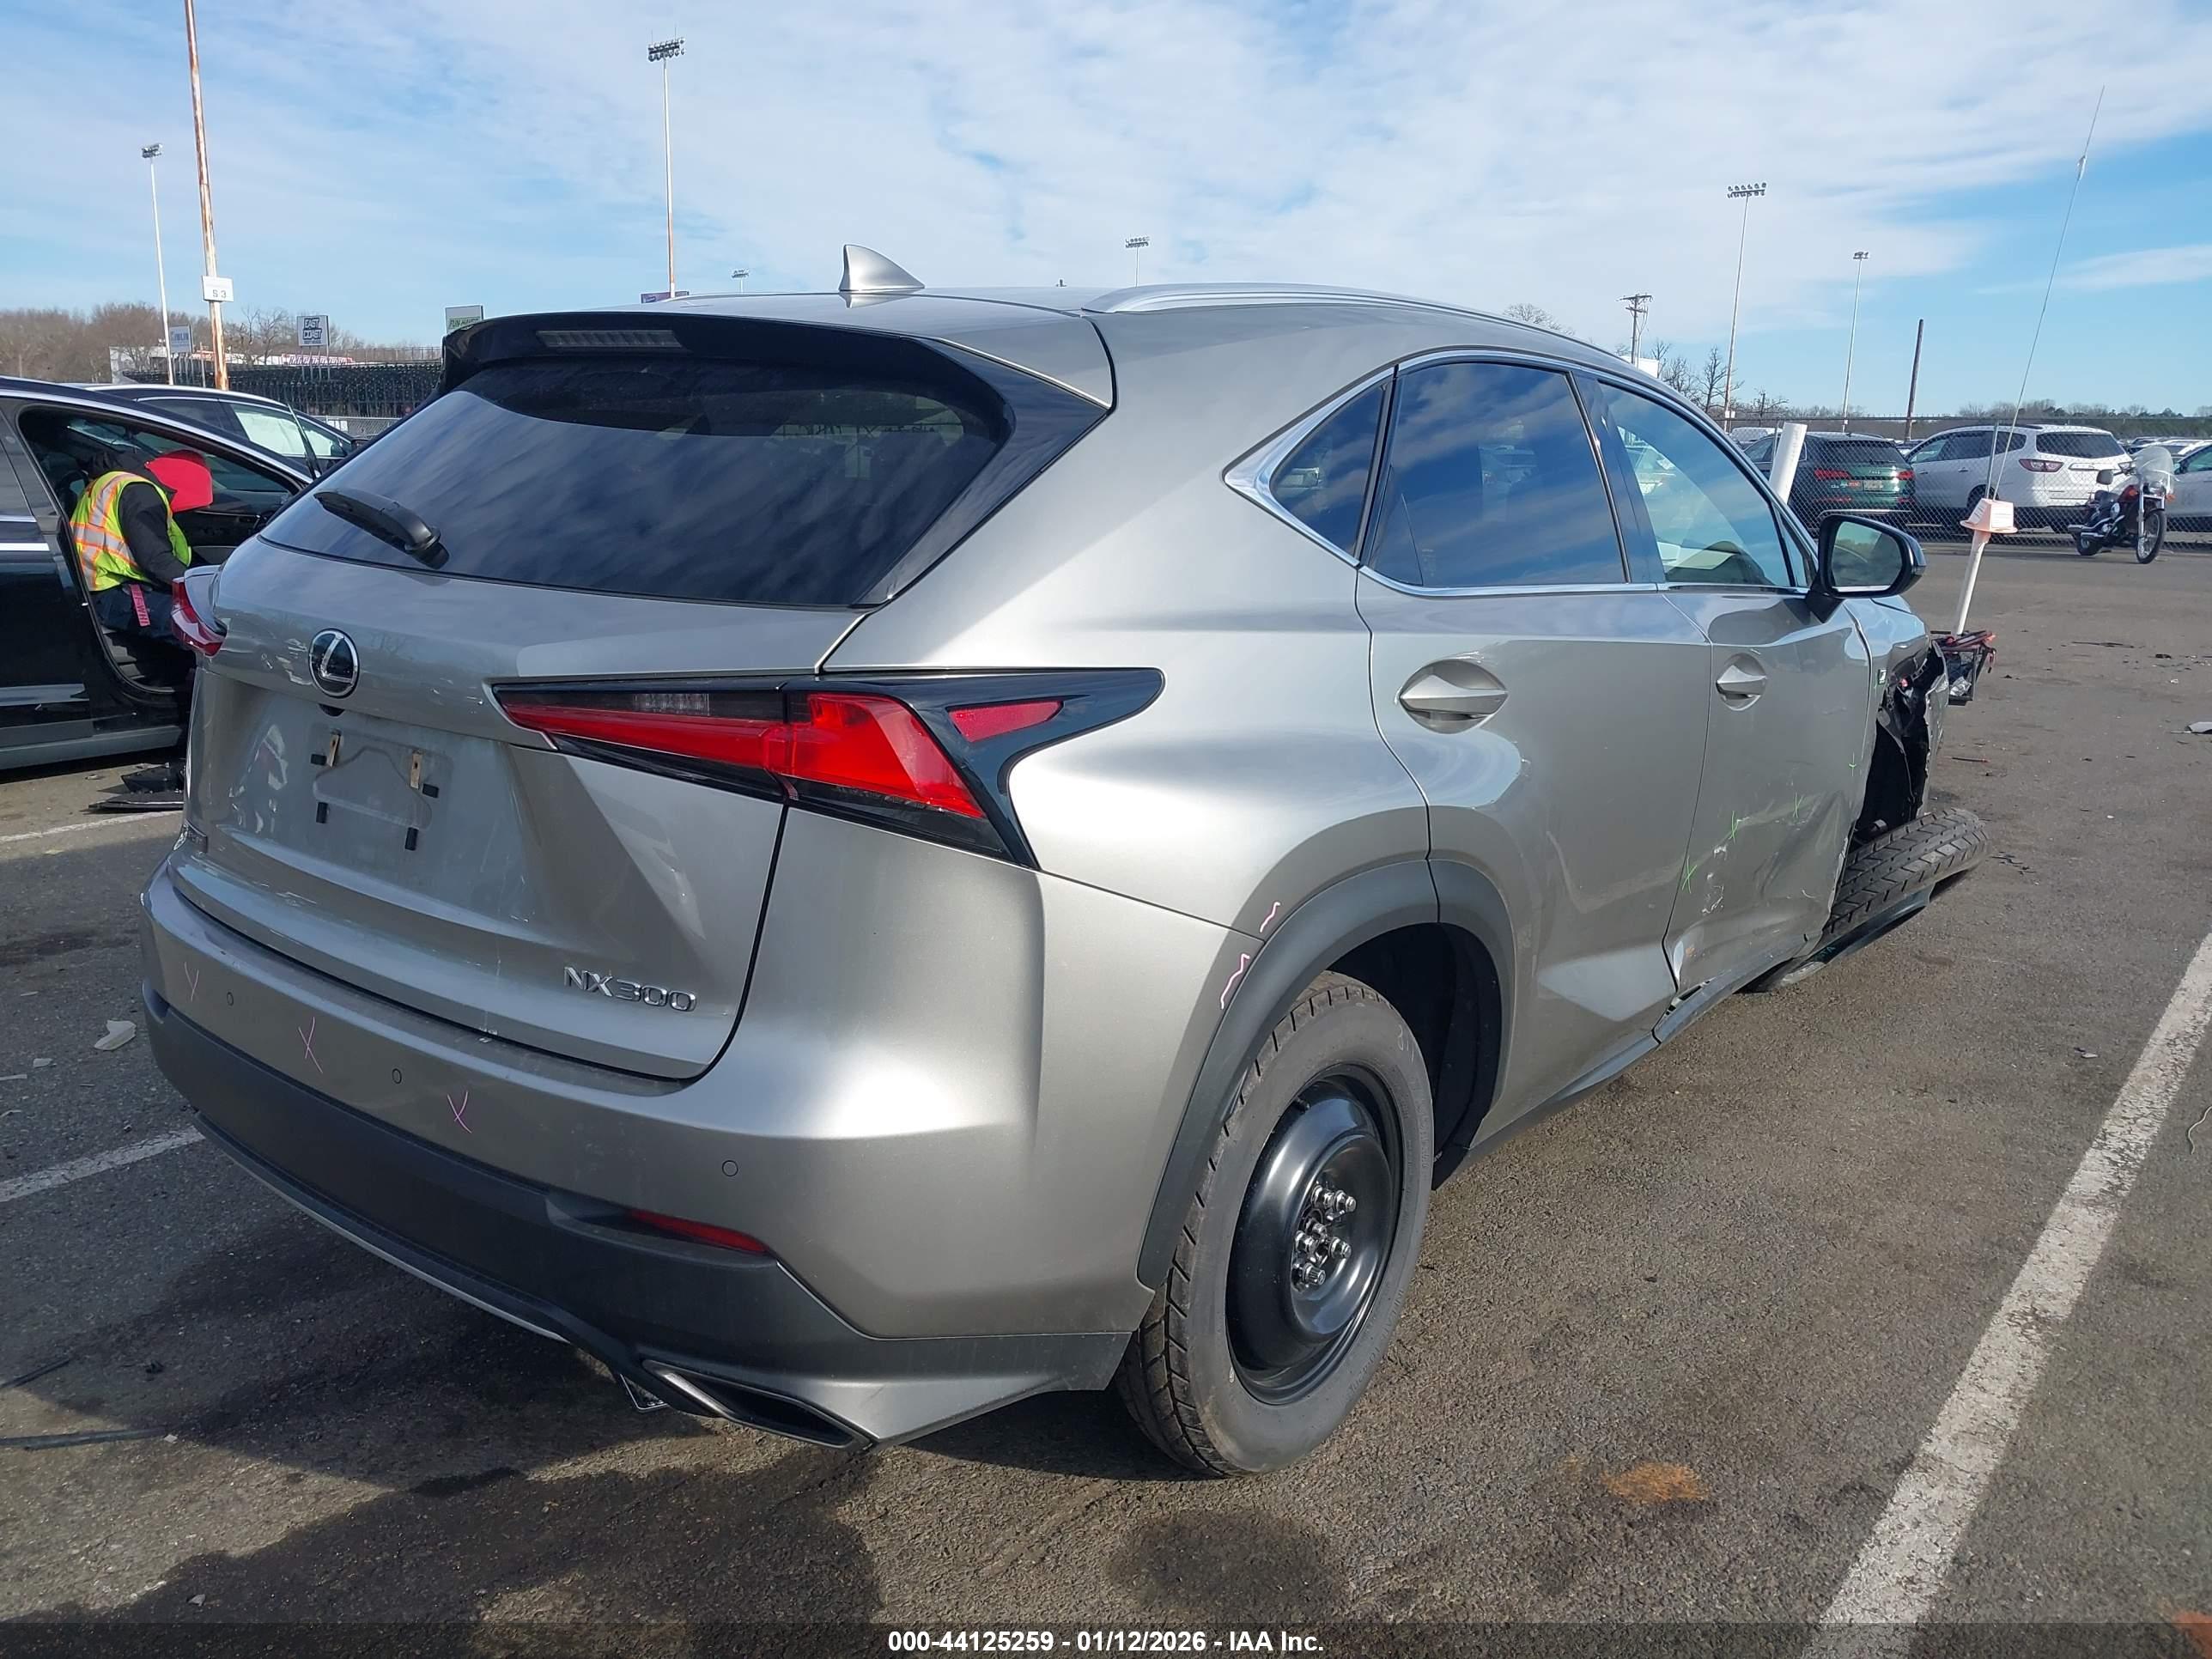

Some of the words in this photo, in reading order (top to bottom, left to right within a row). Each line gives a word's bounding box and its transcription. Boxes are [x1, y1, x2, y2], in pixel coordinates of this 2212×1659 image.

[304, 318, 319, 329] EAST
[303, 329, 322, 340] COAST
[563, 966, 697, 1012] NX300
